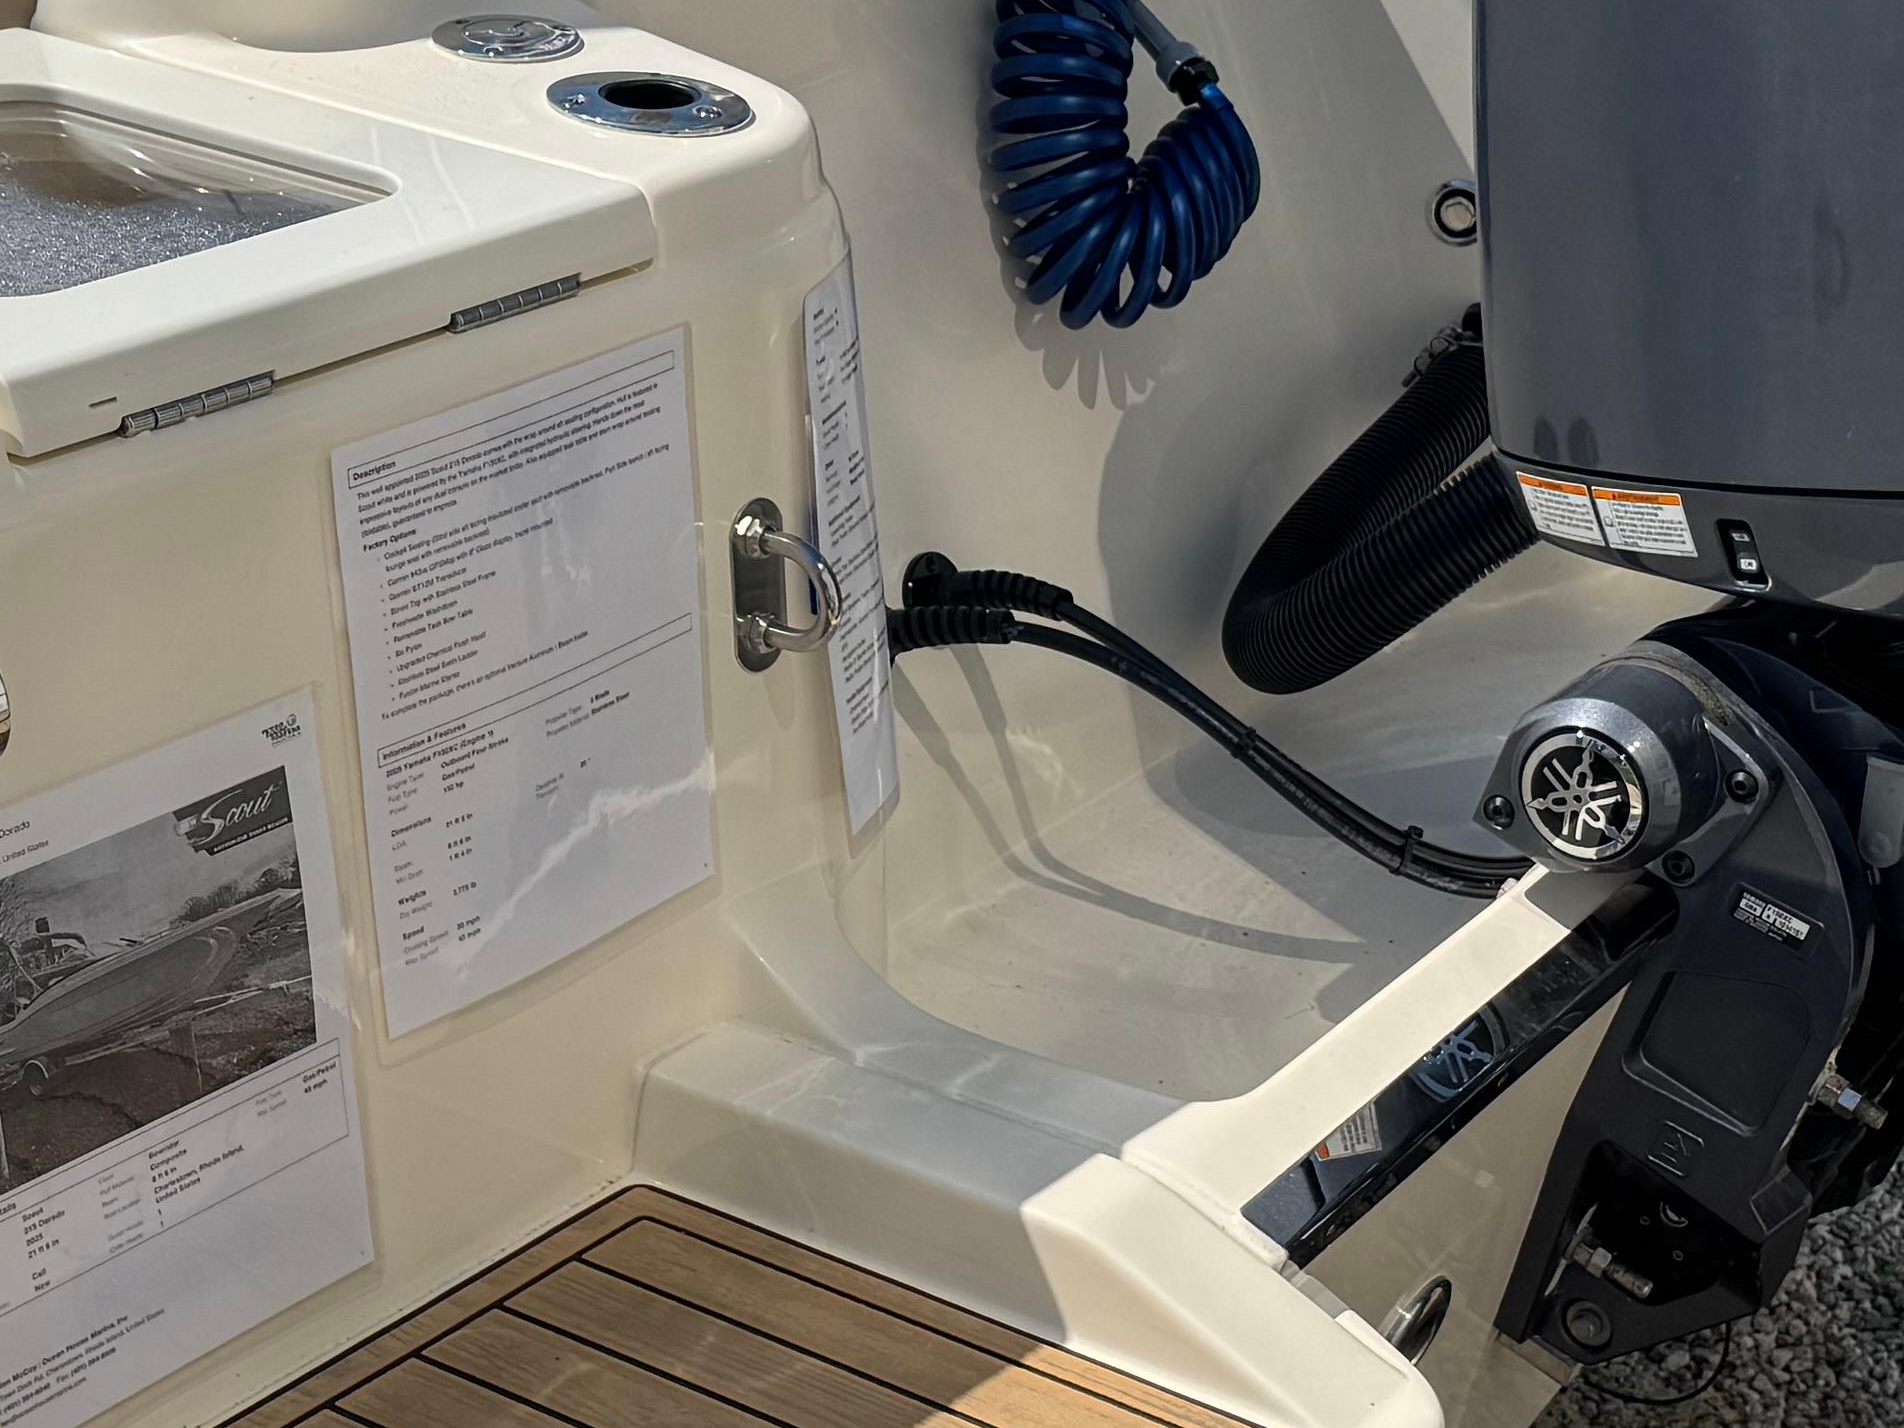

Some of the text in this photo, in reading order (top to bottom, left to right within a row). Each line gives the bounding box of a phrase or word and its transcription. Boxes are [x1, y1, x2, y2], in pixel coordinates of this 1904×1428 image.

[353, 458, 396, 482] Description
[363, 526, 416, 555] Factory Options
[383, 736, 424, 761] Information
[434, 719, 465, 741] Features
[197, 784, 280, 846] Scout
[149, 1146, 187, 1173] Composite
